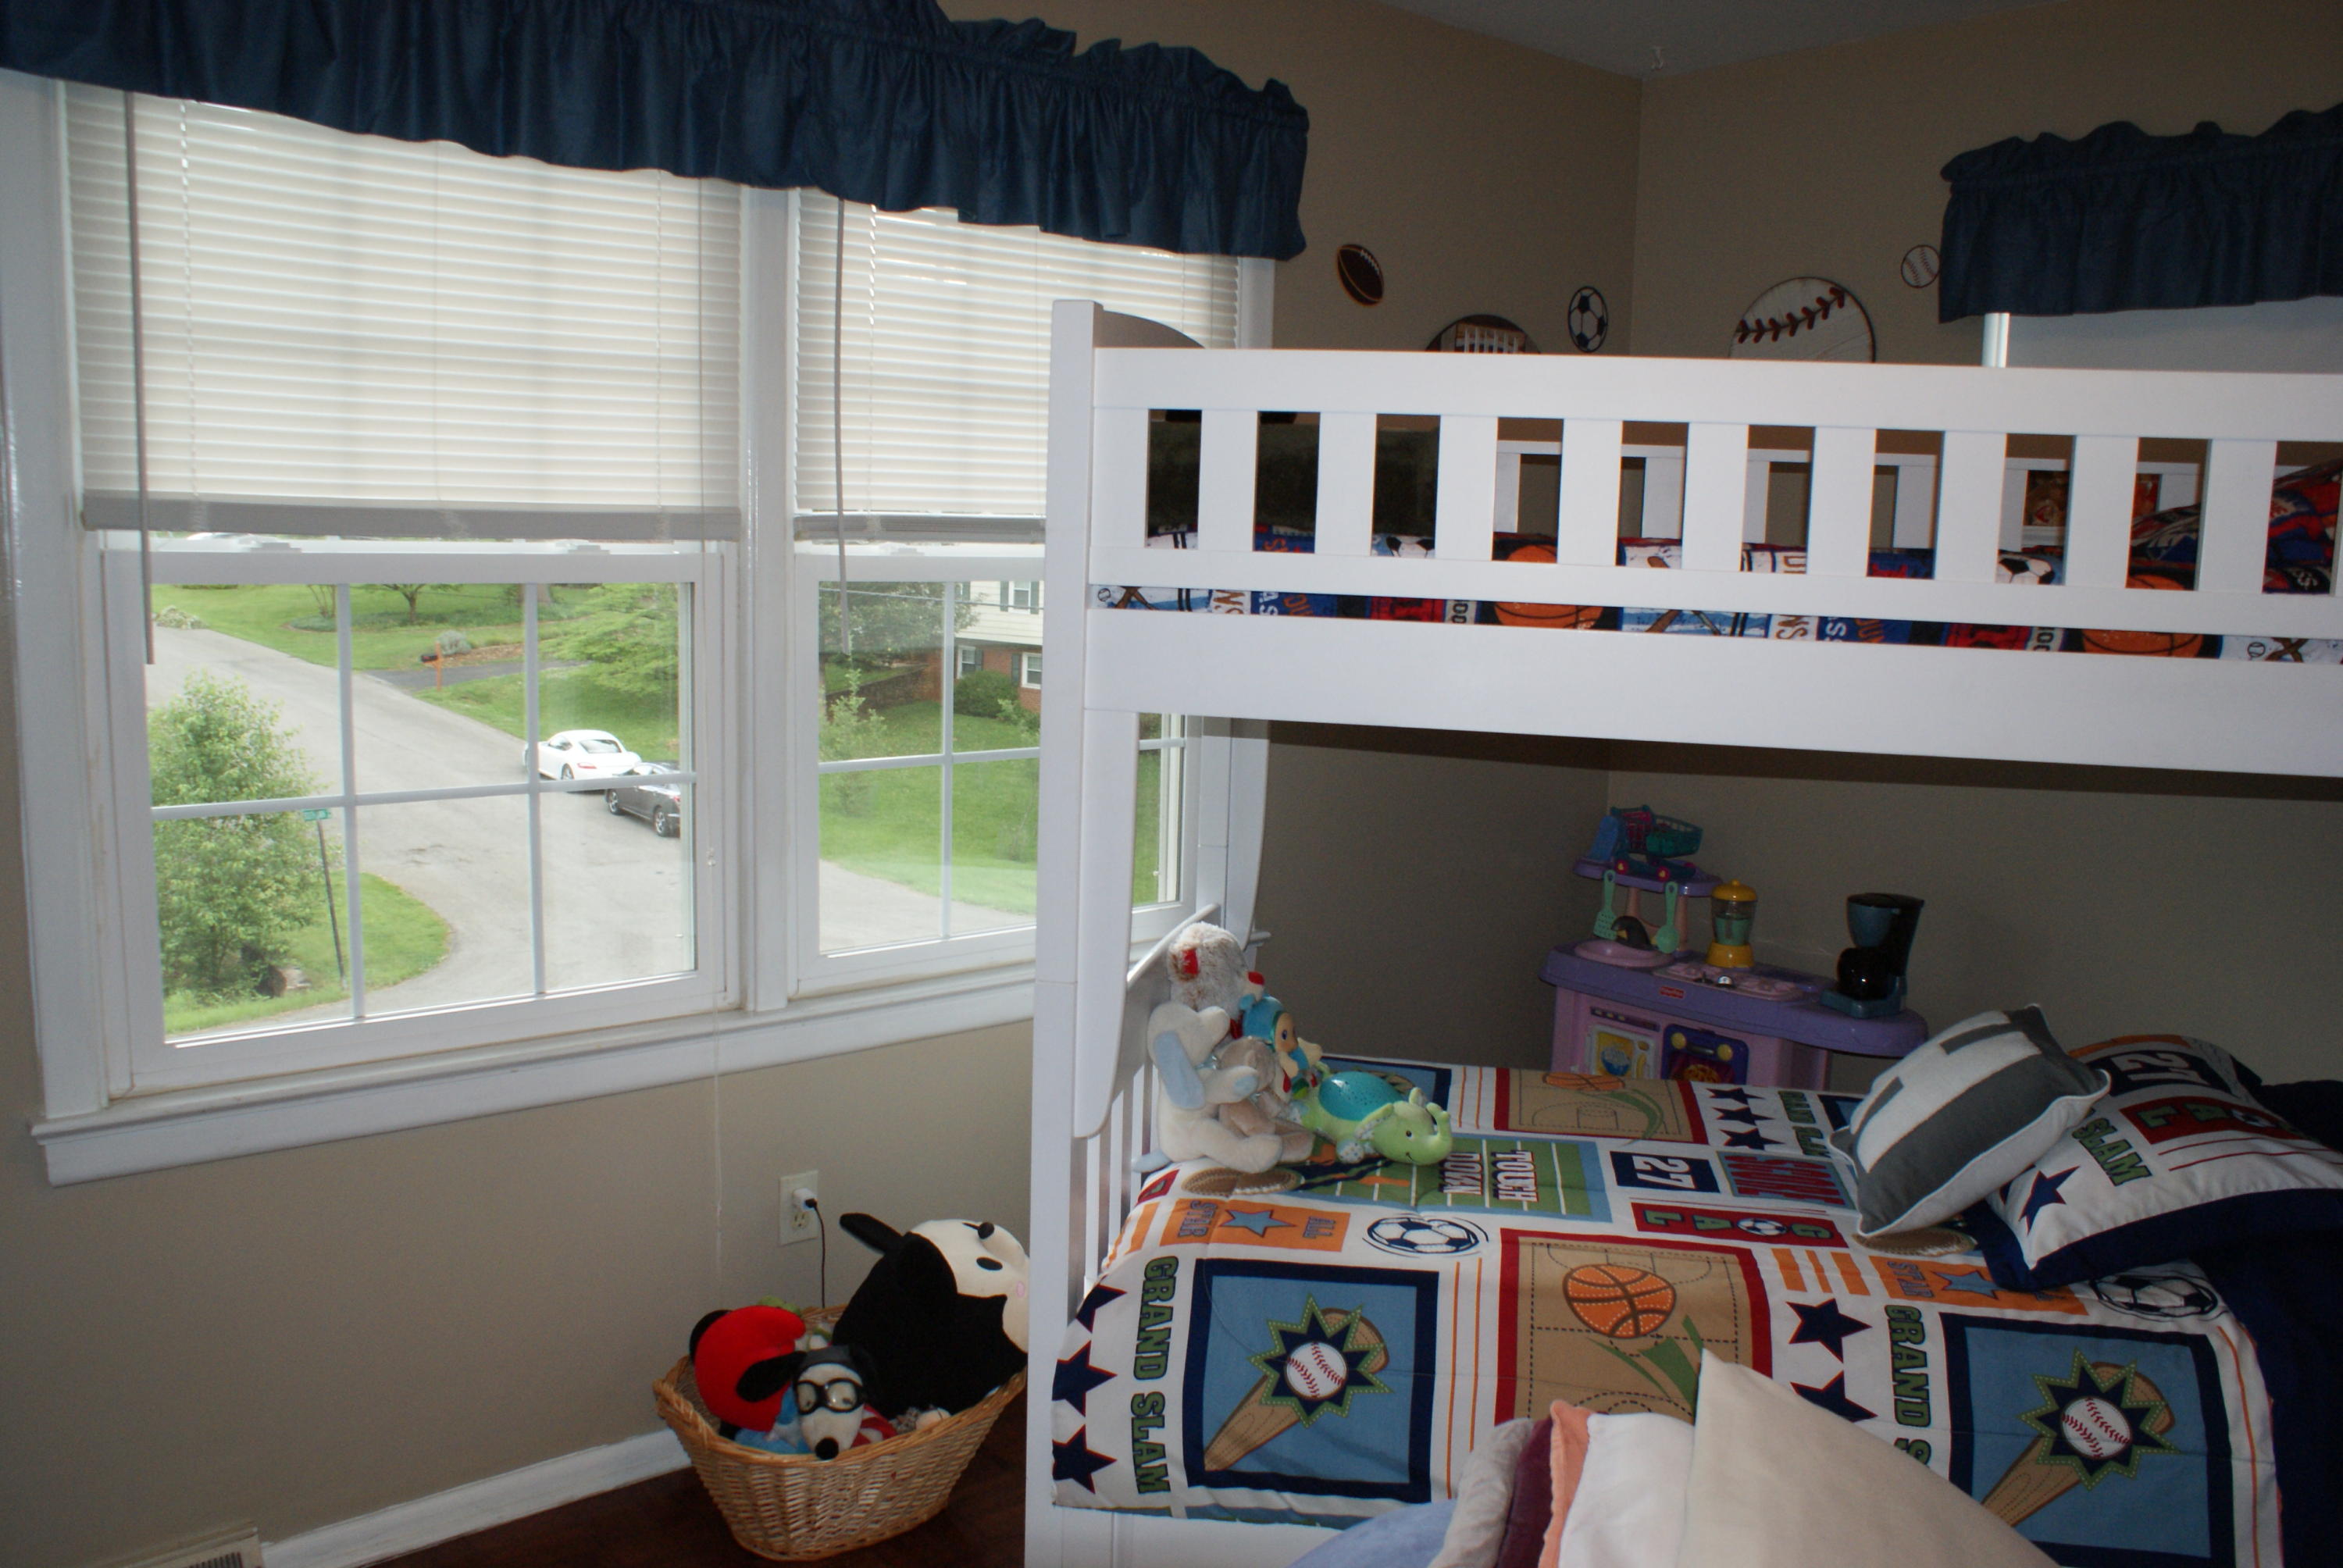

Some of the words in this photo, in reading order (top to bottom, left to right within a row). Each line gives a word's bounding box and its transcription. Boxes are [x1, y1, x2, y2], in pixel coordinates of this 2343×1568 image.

[1439, 1151, 1484, 1196] DOWN
[1491, 1149, 1539, 1203] TOUCH
[1631, 1155, 1698, 1190] 27
[2072, 1117, 2152, 1186] SLAM
[1724, 1156, 1846, 1206] SCORE
[1177, 1200, 1218, 1238] STAR
[1302, 1216, 1337, 1239] ALL
[1887, 1260, 1935, 1299] STAR
[1133, 1256, 1179, 1381] GRAND
[1884, 1304, 1931, 1427] GRAND
[1130, 1391, 1171, 1495] SLAM
